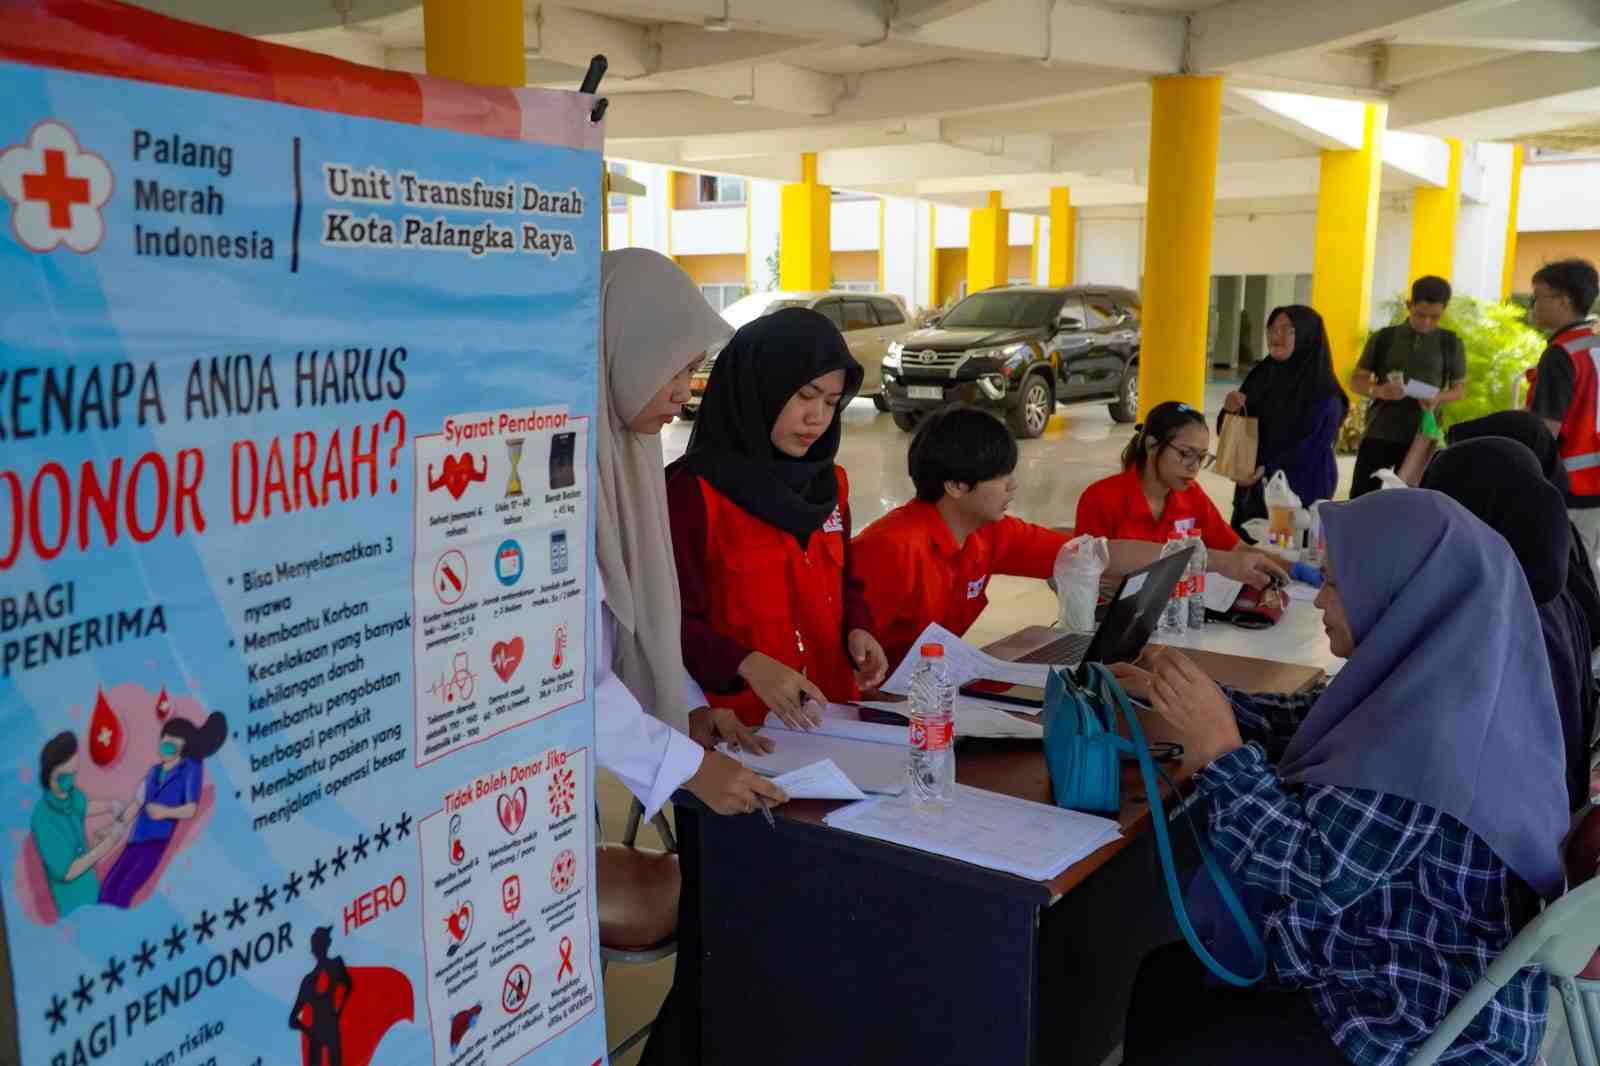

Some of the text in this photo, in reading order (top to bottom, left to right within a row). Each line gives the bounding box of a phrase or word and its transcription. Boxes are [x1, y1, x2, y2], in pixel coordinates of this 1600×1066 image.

[133, 128, 233, 177] Palang
[133, 178, 224, 215] Merah
[327, 166, 582, 214] Unit Transfusi Darah
[135, 223, 275, 260] Indonesia
[325, 214, 575, 256] Kota Palangka Raya
[185, 353, 279, 421] ANDA
[295, 347, 408, 408] HARUS
[445, 411, 569, 447] Syarat Pendonor
[231, 408, 407, 525] DARAH?
[243, 536, 393, 592] Bisa Menyelamatkan 3
[0, 581, 75, 632] BAGI
[243, 601, 368, 653] Membantu Korban
[244, 597, 292, 624] nyawa
[3, 604, 168, 678] PENERIMA
[248, 611, 412, 684] Kecelakaan yang banyak
[247, 672, 400, 743] Membantu pengobatan
[248, 654, 365, 714] kehilangan darah
[250, 706, 371, 774] berbagai penyakit
[251, 724, 402, 802] Membantu pasien yang
[252, 747, 407, 832] menjalani operasi besar
[445, 750, 567, 813] Tidak Boleh Donor Jika
[344, 874, 406, 937] HERO
[125, 922, 293, 1037] PENDONOR
[179, 1020, 225, 1061] risiko
